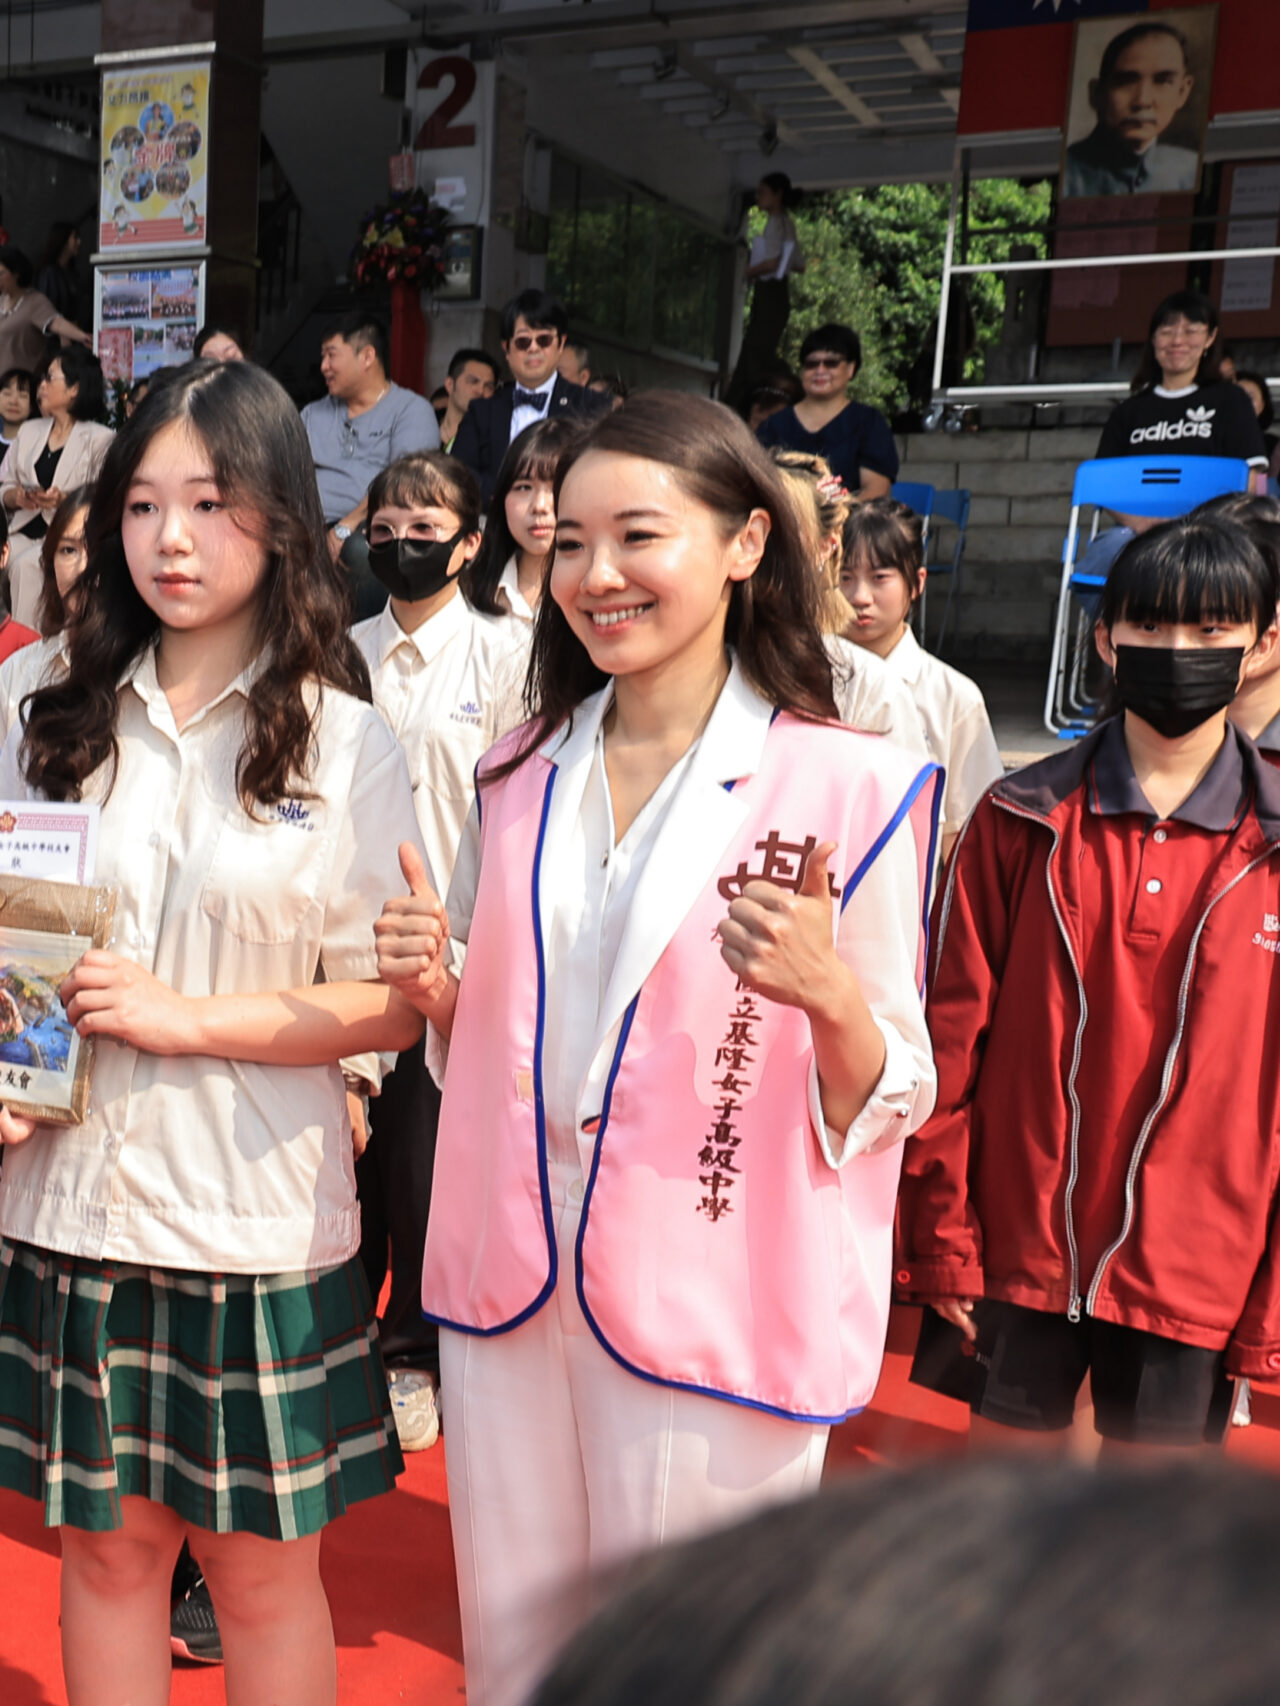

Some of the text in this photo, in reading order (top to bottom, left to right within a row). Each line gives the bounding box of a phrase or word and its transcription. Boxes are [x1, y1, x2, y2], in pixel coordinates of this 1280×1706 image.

[416, 56, 477, 149] 2
[1130, 419, 1212, 444] adidas
[695, 977, 763, 1223] 立基隆女子高級中學
